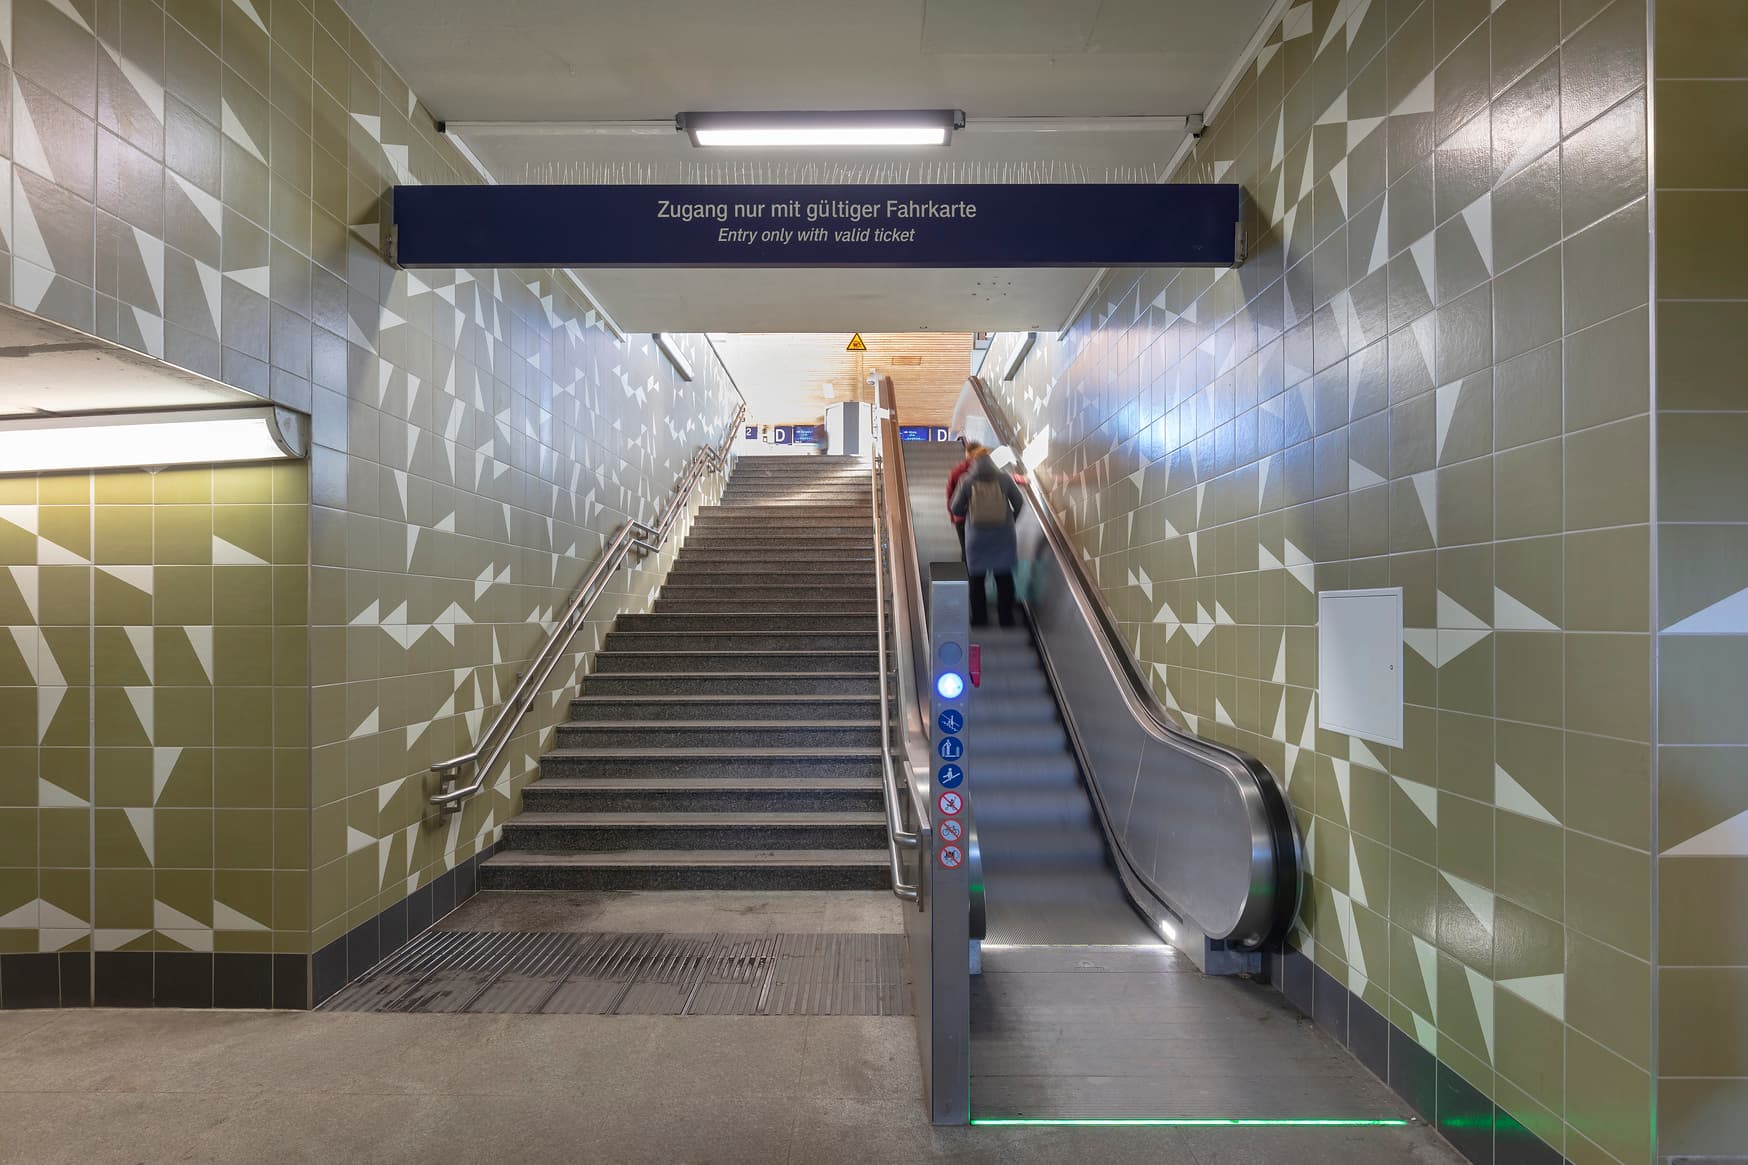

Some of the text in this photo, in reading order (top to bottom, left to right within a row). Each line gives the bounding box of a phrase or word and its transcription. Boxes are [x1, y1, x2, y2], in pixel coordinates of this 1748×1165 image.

[657, 200, 977, 222] Zugang nur mit gültiger Fahrkarte
[717, 228, 916, 245] Entry only with valid ticket
[775, 429, 785, 442] D
[937, 429, 947, 441] D
